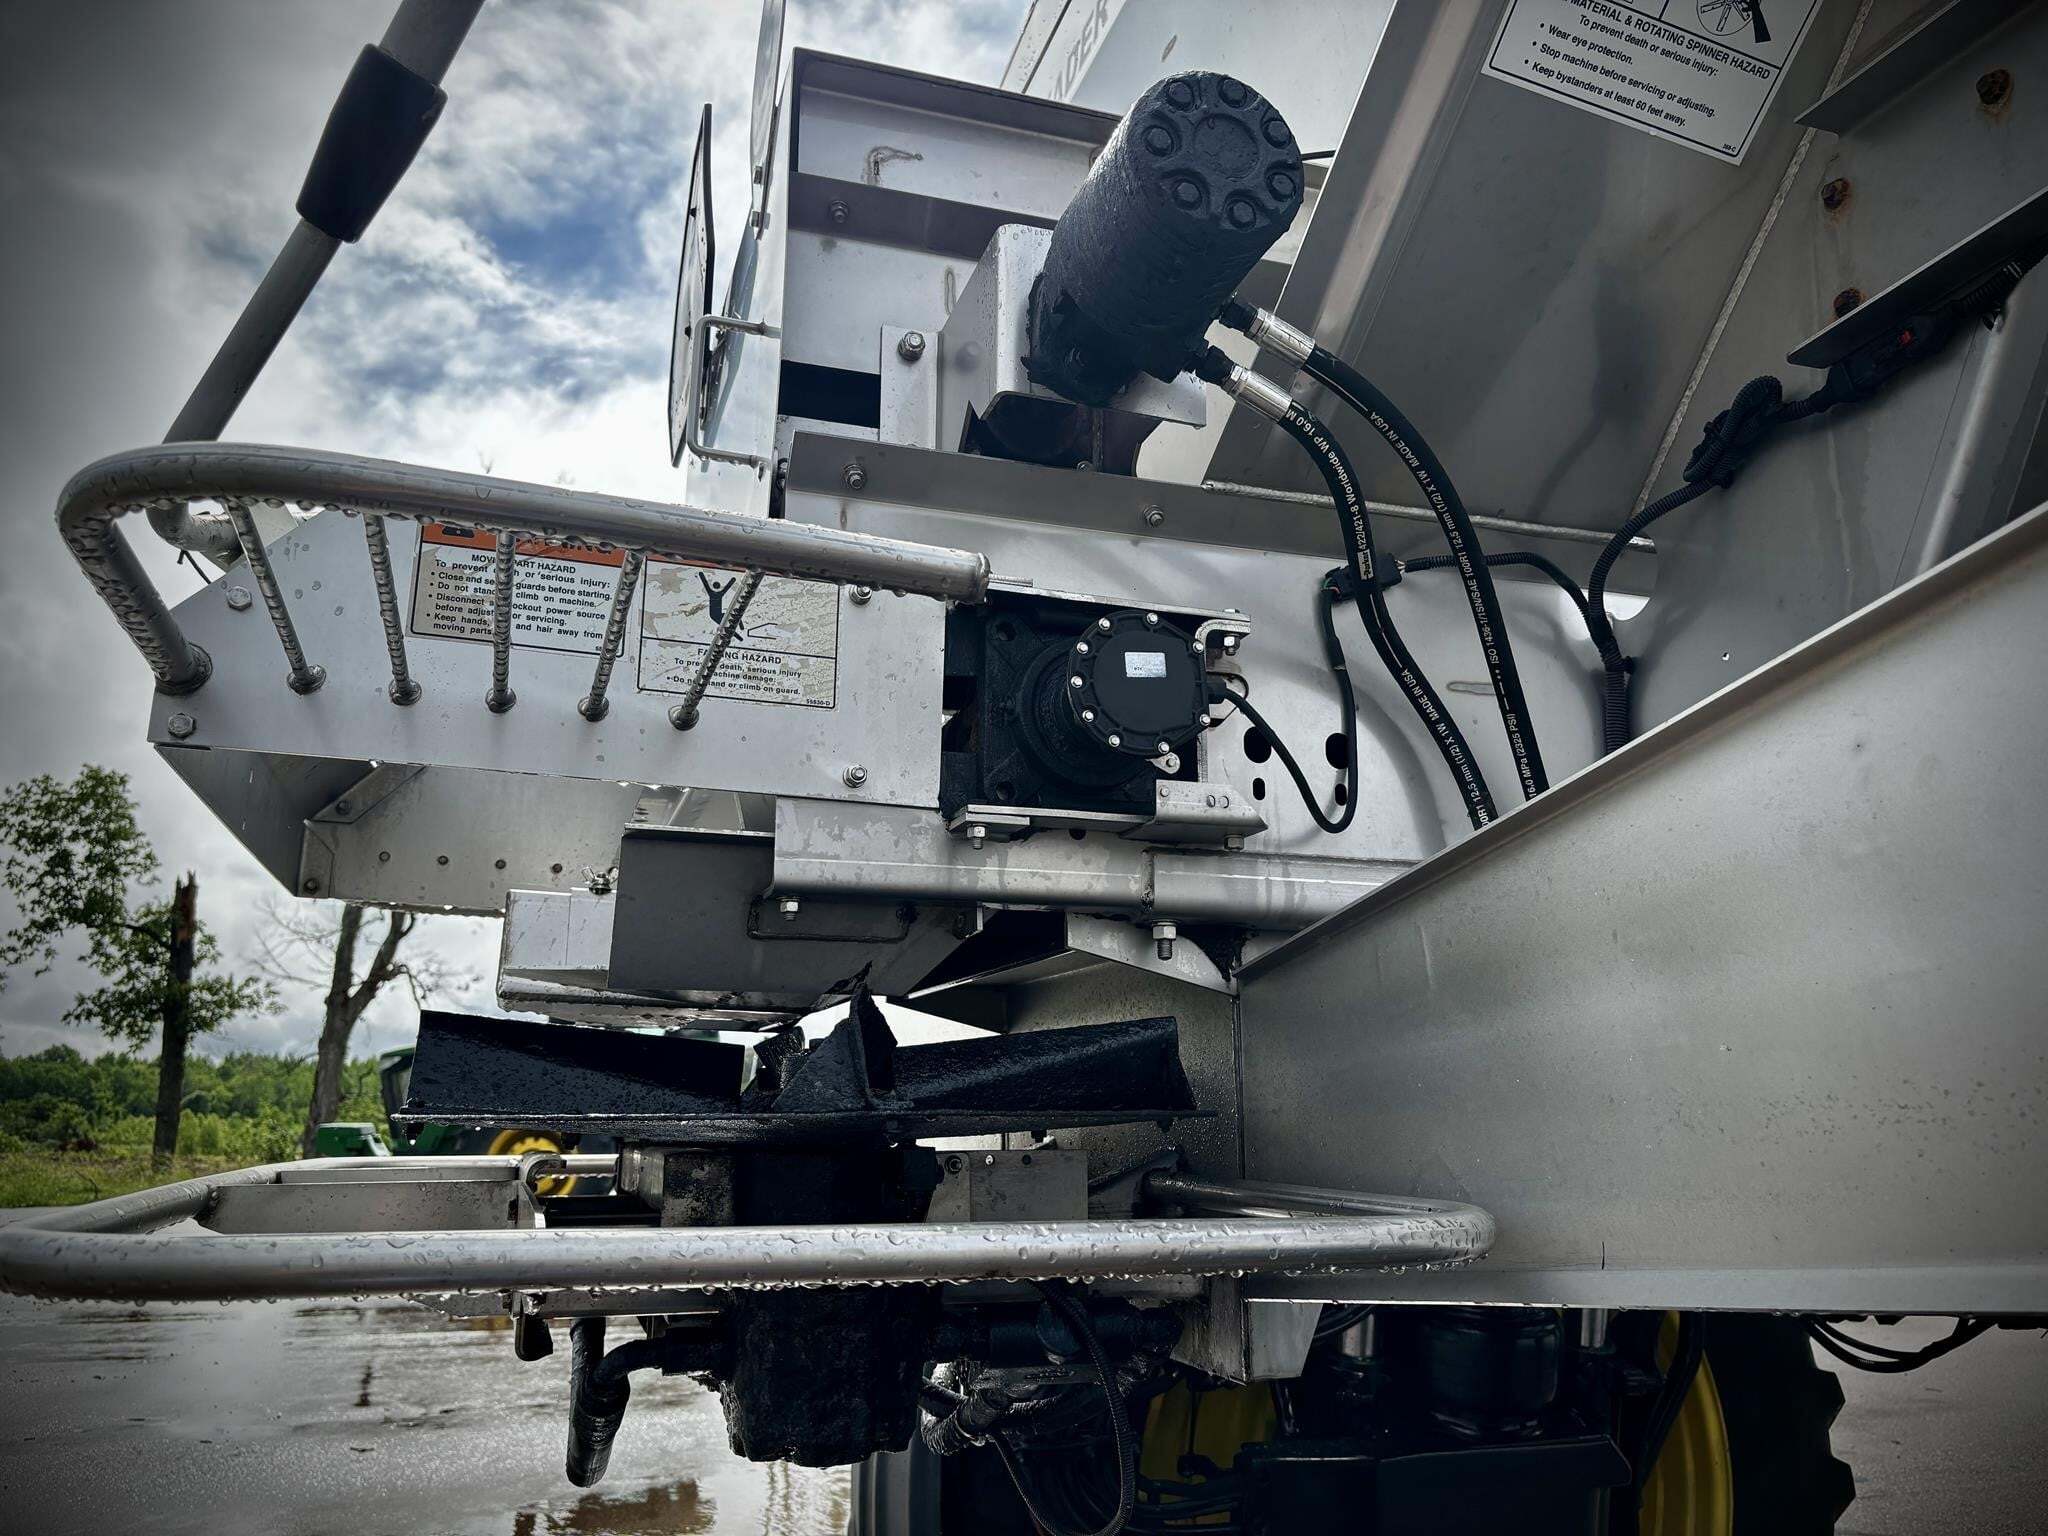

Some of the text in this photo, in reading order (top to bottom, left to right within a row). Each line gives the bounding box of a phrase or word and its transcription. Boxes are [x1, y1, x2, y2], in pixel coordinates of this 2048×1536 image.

[1549, 24, 1633, 65] Wear eye protection.
[1569, 0, 1771, 80] MATERIAL & ROTATING SPINNER HAZARD
[1579, 14, 1718, 76] To prevent death or serious injury:
[1539, 43, 1716, 118] Stop machine before servicing or adjusting.
[1531, 61, 1686, 127] Keep bystanders at least 60 feet away.
[1369, 411, 1390, 432] USA
[1313, 436, 1330, 454] WP
[1387, 430, 1399, 442] IN
[1396, 439, 1420, 468] MADE
[1328, 450, 1357, 504] Worldwide
[1416, 469, 1431, 485] 1W
[1427, 484, 1437, 492] X
[1431, 491, 1448, 514] (1/2)
[1350, 504, 1368, 550] 422/421-8
[1443, 512, 1457, 531] mm
[435, 559, 447, 568] To
[452, 561, 488, 573] prevent
[525, 571, 536, 579] or
[540, 573, 575, 584] serious
[580, 577, 611, 589] injury:
[537, 562, 576, 574] HAZARD
[1459, 551, 1475, 577] 100R1
[437, 581, 450, 590] Do
[454, 584, 469, 592] not
[515, 592, 539, 601] climb
[438, 571, 464, 582] Close
[465, 575, 483, 584] and
[515, 582, 546, 592] guards
[548, 584, 576, 596] before
[577, 590, 612, 601] starting.
[435, 603, 567, 627] before adjust or servicing.
[436, 593, 485, 606] Disconnect
[512, 603, 542, 613] ockout
[546, 607, 573, 616] power
[576, 610, 606, 620] source
[433, 623, 465, 634] moving
[434, 613, 603, 640] Keep hands, and hair away from
[742, 651, 782, 665] HAZARD
[1487, 648, 1500, 664] ISO
[674, 657, 684, 665] To
[719, 662, 745, 672] death,
[747, 665, 777, 675] serious
[779, 669, 802, 679] injury
[713, 671, 741, 680] achine
[1401, 668, 1416, 688] USA
[673, 675, 685, 683] Do
[738, 682, 761, 691] climb
[762, 684, 774, 692] on
[775, 686, 801, 695] guard.
[1413, 686, 1424, 698] IN
[1418, 696, 1440, 721] MADE
[1435, 721, 1449, 737] 1W
[1506, 712, 1518, 730] PSI)
[1444, 736, 1454, 745] X
[1510, 732, 1525, 757] (2325
[1449, 744, 1466, 765] (1/2)
[1461, 763, 1473, 782] mm
[1520, 757, 1532, 777] MPa
